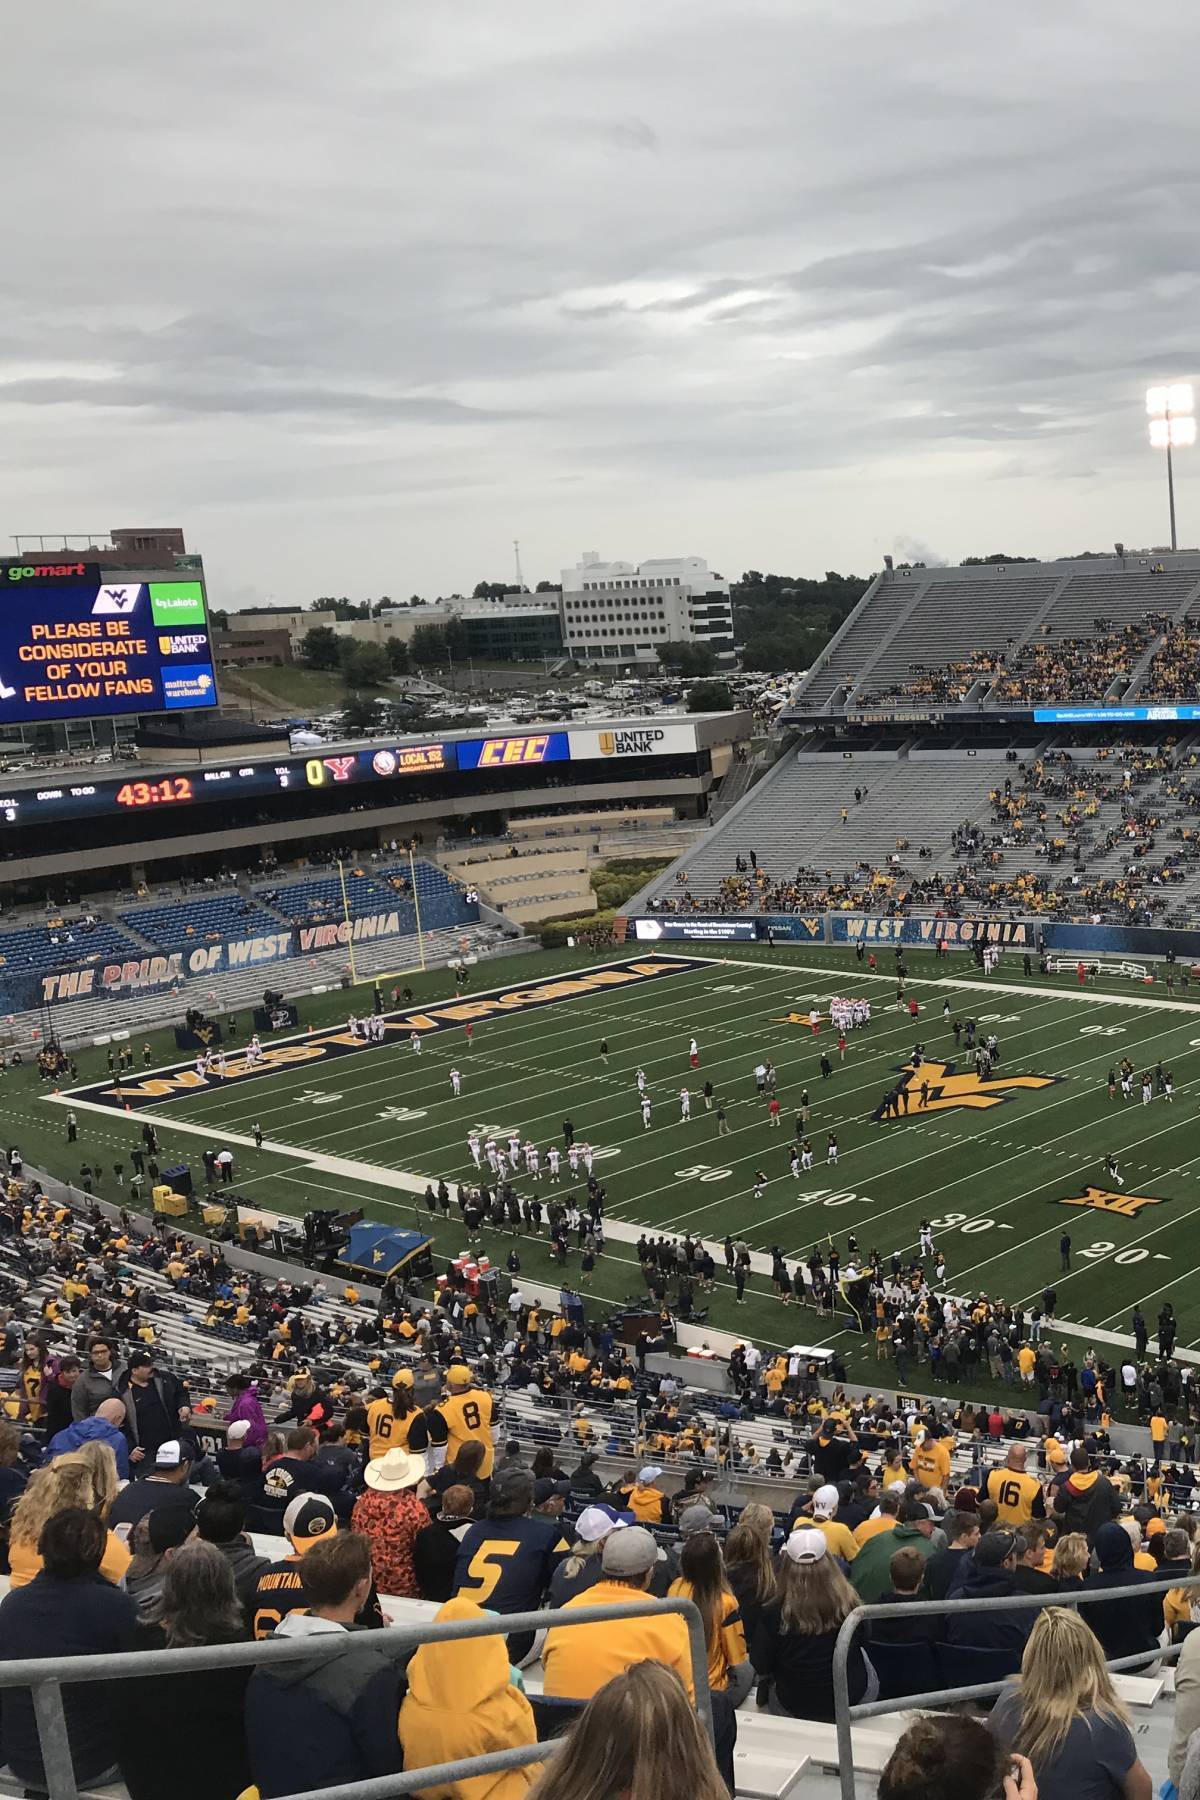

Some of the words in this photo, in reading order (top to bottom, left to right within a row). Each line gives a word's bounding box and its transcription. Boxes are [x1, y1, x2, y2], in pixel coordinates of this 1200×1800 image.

[8, 563, 86, 580] gomart
[31, 622, 101, 640] PLEASE
[106, 620, 130, 637] BE
[170, 634, 207, 645] UNITED
[18, 639, 148, 661] CONSIDERATE
[171, 643, 199, 654] BANK
[46, 663, 72, 680] OF
[76, 660, 127, 678] YOUR
[24, 682, 100, 702] FELLOW
[104, 678, 154, 696] FANS
[614, 729, 664, 743] UNITED
[616, 741, 653, 754] BANK
[323, 756, 355, 781] Y
[400, 752, 427, 766] LOCAL
[280, 775, 288, 787] 3
[305, 759, 323, 786] 0
[37, 789, 63, 801] DOWN
[70, 787, 82, 797] TO
[82, 786, 96, 795] GO
[117, 777, 193, 806] 43:12
[5, 808, 17, 822] 3
[299, 911, 400, 951] VIRGINIA
[846, 919, 905, 938] WEST
[920, 920, 1027, 943] VIRGINIA
[42, 969, 95, 1001] THE
[103, 952, 185, 991] PRIDE
[189, 945, 223, 972] OF
[227, 932, 292, 965] WEST
[100, 1031, 371, 1098] WEST
[382, 960, 685, 1030] VIRGINIA
[673, 1164, 733, 1182] 50
[797, 1187, 858, 1207] 40
[929, 1212, 996, 1234] 30
[1074, 1240, 1150, 1265] 20
[26, 1377, 41, 1398] 7
[462, 1401, 481, 1430] 8
[375, 1414, 394, 1439] 16
[999, 1480, 1021, 1507] 16
[457, 1539, 521, 1605] 5
